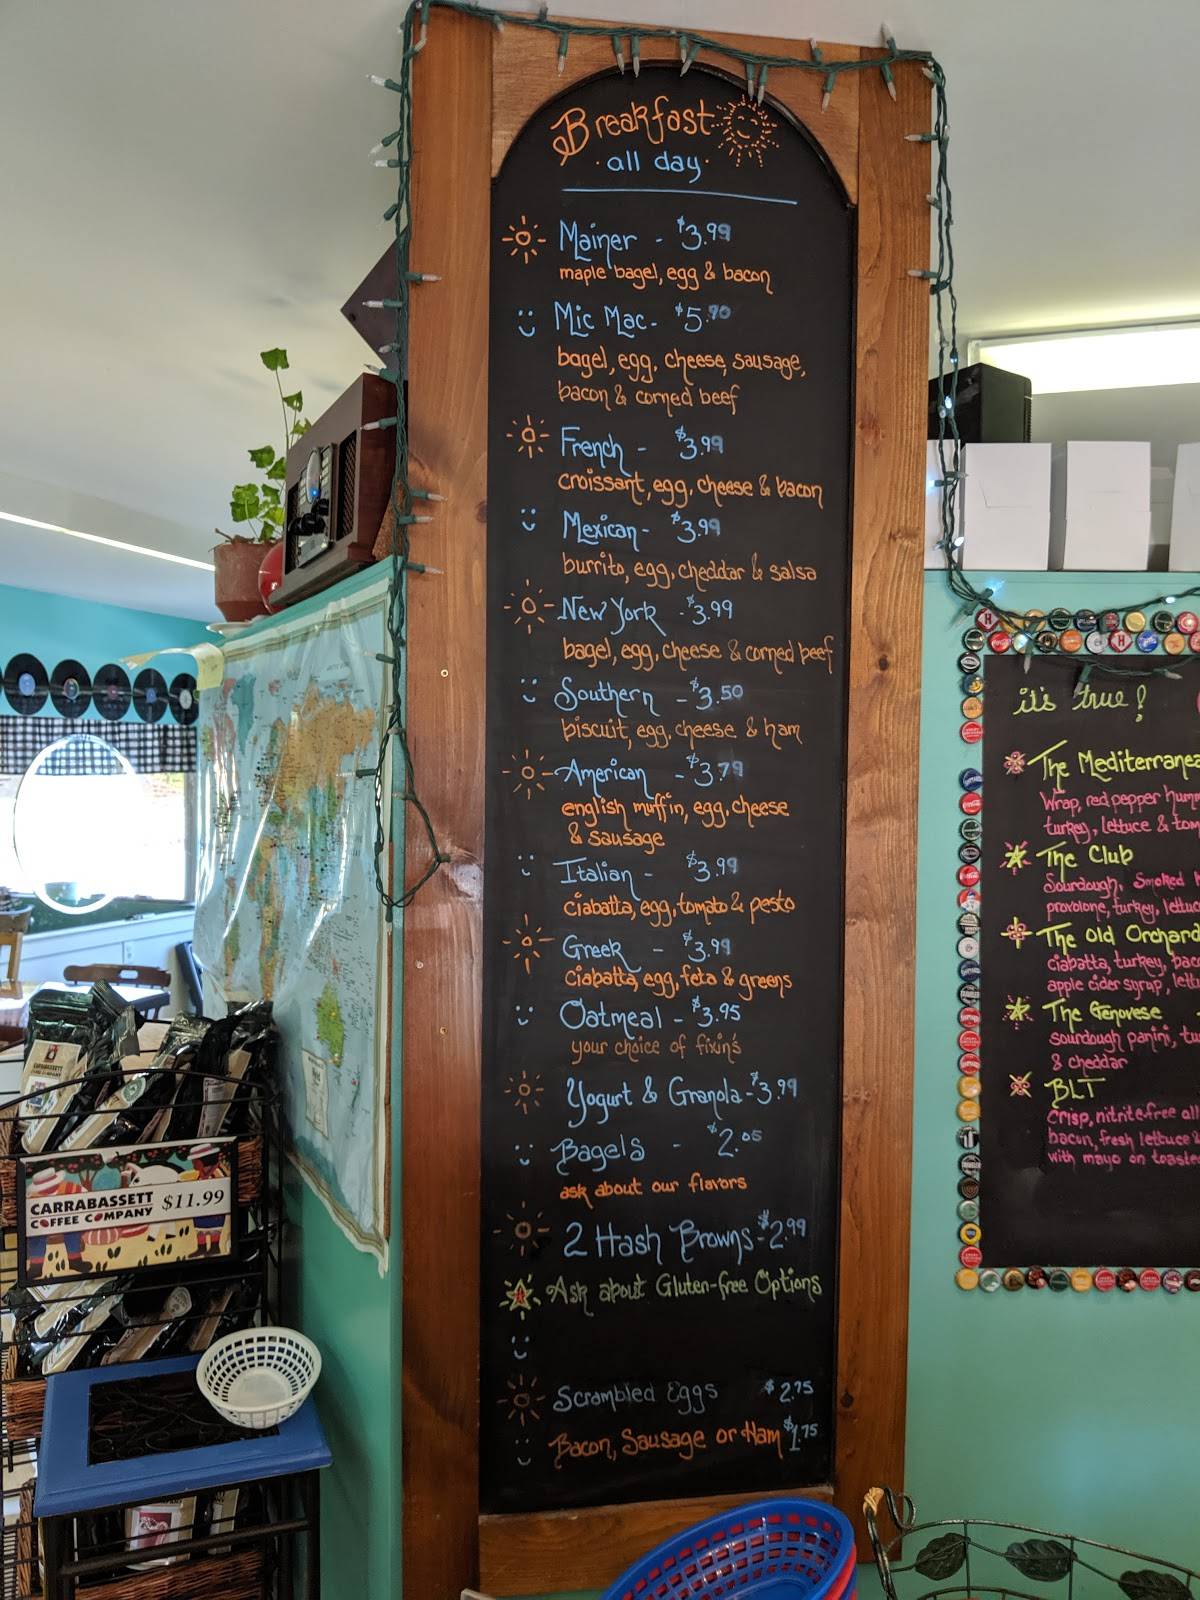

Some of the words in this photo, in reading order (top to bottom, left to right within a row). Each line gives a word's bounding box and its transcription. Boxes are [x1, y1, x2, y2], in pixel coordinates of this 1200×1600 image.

[551, 96, 715, 166] Breakfast
[607, 151, 641, 172] all
[654, 152, 701, 183] day
[559, 220, 638, 269] Mainer
[676, 215, 731, 250] $3.99
[559, 265, 607, 286] maple
[612, 262, 661, 291] bagel,
[666, 268, 698, 291] egg
[704, 261, 716, 280] &
[722, 263, 774, 295] bacon
[554, 301, 595, 338] Mic
[557, 345, 616, 377] bagel,
[664, 349, 727, 386] cheese,
[731, 352, 806, 381] sausage,
[558, 382, 612, 411] bacon
[614, 386, 627, 406] &
[635, 387, 693, 417] corned
[699, 385, 741, 415] beef
[560, 426, 632, 477] French
[674, 425, 724, 459] $3.99
[558, 468, 652, 505] croissant,
[652, 478, 694, 508] egg,
[697, 474, 753, 507] cheese
[759, 473, 771, 496] &
[776, 476, 824, 509] bacon
[670, 511, 721, 543] $3.99
[562, 552, 630, 584] burrito,
[634, 564, 675, 590] egg,
[678, 562, 746, 592] cheddar
[752, 552, 763, 581] &
[769, 562, 817, 581] salsa
[557, 595, 608, 622] New
[610, 596, 667, 636] York
[686, 595, 734, 625] $3.99
[563, 637, 617, 668] bagel,
[620, 643, 660, 672] egg,
[662, 639, 722, 672] cheese
[728, 639, 741, 662] &
[745, 639, 795, 675] corned
[799, 635, 835, 674] beef
[554, 676, 660, 718] Southern
[689, 676, 744, 710] $3.50
[560, 716, 633, 750] biscuit,
[674, 720, 738, 750] cheese
[746, 717, 757, 737] &
[763, 718, 802, 750] ham
[554, 758, 655, 800] American
[686, 752, 744, 787] $3.79
[1027, 740, 1070, 793] The
[561, 797, 632, 832] english
[633, 793, 689, 824] muffin,
[692, 801, 730, 828] egg,
[731, 795, 790, 828] cheese
[1039, 790, 1083, 817] Wrap,
[1086, 791, 1110, 808] red
[1111, 791, 1161, 815] pepper
[568, 821, 582, 845] &
[588, 829, 665, 855] sausage
[1044, 815, 1098, 844] turkey,
[1101, 816, 1152, 834] lettuce
[1157, 814, 1169, 832] &
[552, 856, 641, 901] Italian
[686, 850, 739, 883] $3.99
[1036, 841, 1078, 883] The
[1089, 844, 1133, 866] Club
[1044, 873, 1123, 899] Sourdough,
[1133, 872, 1185, 896] Smoked
[640, 902, 677, 927] egg,
[679, 893, 728, 925] tomato
[730, 892, 744, 914] &
[750, 889, 796, 925] pesto
[1047, 902, 1111, 922] provolone,
[1112, 899, 1160, 925] turkey,
[562, 934, 642, 972] Greek
[682, 929, 731, 963] $3.99
[1036, 922, 1077, 955] The
[1086, 925, 1115, 946] Old
[643, 975, 680, 997] egg,
[680, 963, 718, 987] feta
[721, 967, 735, 986] &
[739, 971, 792, 1000] greens
[1113, 950, 1167, 978] turkey,
[1047, 978, 1084, 999] apple
[1088, 974, 1121, 991] cider
[559, 999, 663, 1039] Oatmeal
[691, 996, 741, 1027] $3.95
[1042, 998, 1082, 1033] The
[1090, 1001, 1163, 1027] Genovese
[571, 1038, 608, 1065] your
[614, 1036, 660, 1063] choice
[670, 1034, 687, 1060] of
[695, 1032, 742, 1064] fixin's
[1049, 1029, 1125, 1053] sourdough
[1127, 1025, 1177, 1052] panini,
[1068, 1053, 1128, 1077] cheddar
[566, 1077, 634, 1128] Yogurt
[642, 1076, 658, 1104] &
[1044, 1077, 1106, 1109] BLT
[550, 1134, 645, 1176] Bagels
[707, 1122, 763, 1157] $2.05
[1100, 1129, 1134, 1150] fresh
[1140, 1130, 1190, 1146] lettuce
[1047, 1151, 1076, 1172] with
[1083, 1153, 1121, 1172] mayo
[1129, 1153, 1146, 1165] on
[30, 1191, 153, 1216] CARRABASSETT
[161, 1189, 225, 1211] $11.99
[560, 1180, 594, 1210] ask
[595, 1177, 643, 1197] about
[651, 1178, 680, 1194] our
[688, 1172, 748, 1194] flavors
[30, 1216, 79, 1229] COFFEE
[85, 1207, 153, 1223] COMPANY
[563, 1221, 589, 1258] 2
[595, 1223, 663, 1265] Hash
[669, 1218, 754, 1265] Browns
[546, 1275, 595, 1317] Ask
[599, 1273, 648, 1302] about
[655, 1270, 749, 1301] Gluten-free
[754, 1267, 823, 1300] Options
[552, 1376, 656, 1413] Scrambled
[666, 1379, 719, 1415] Eggs
[548, 1432, 617, 1470] Bacon,
[621, 1428, 706, 1460] Sausage
[715, 1426, 738, 1444] or
[741, 1421, 783, 1458] Ham
[783, 1416, 818, 1451] $1.75
